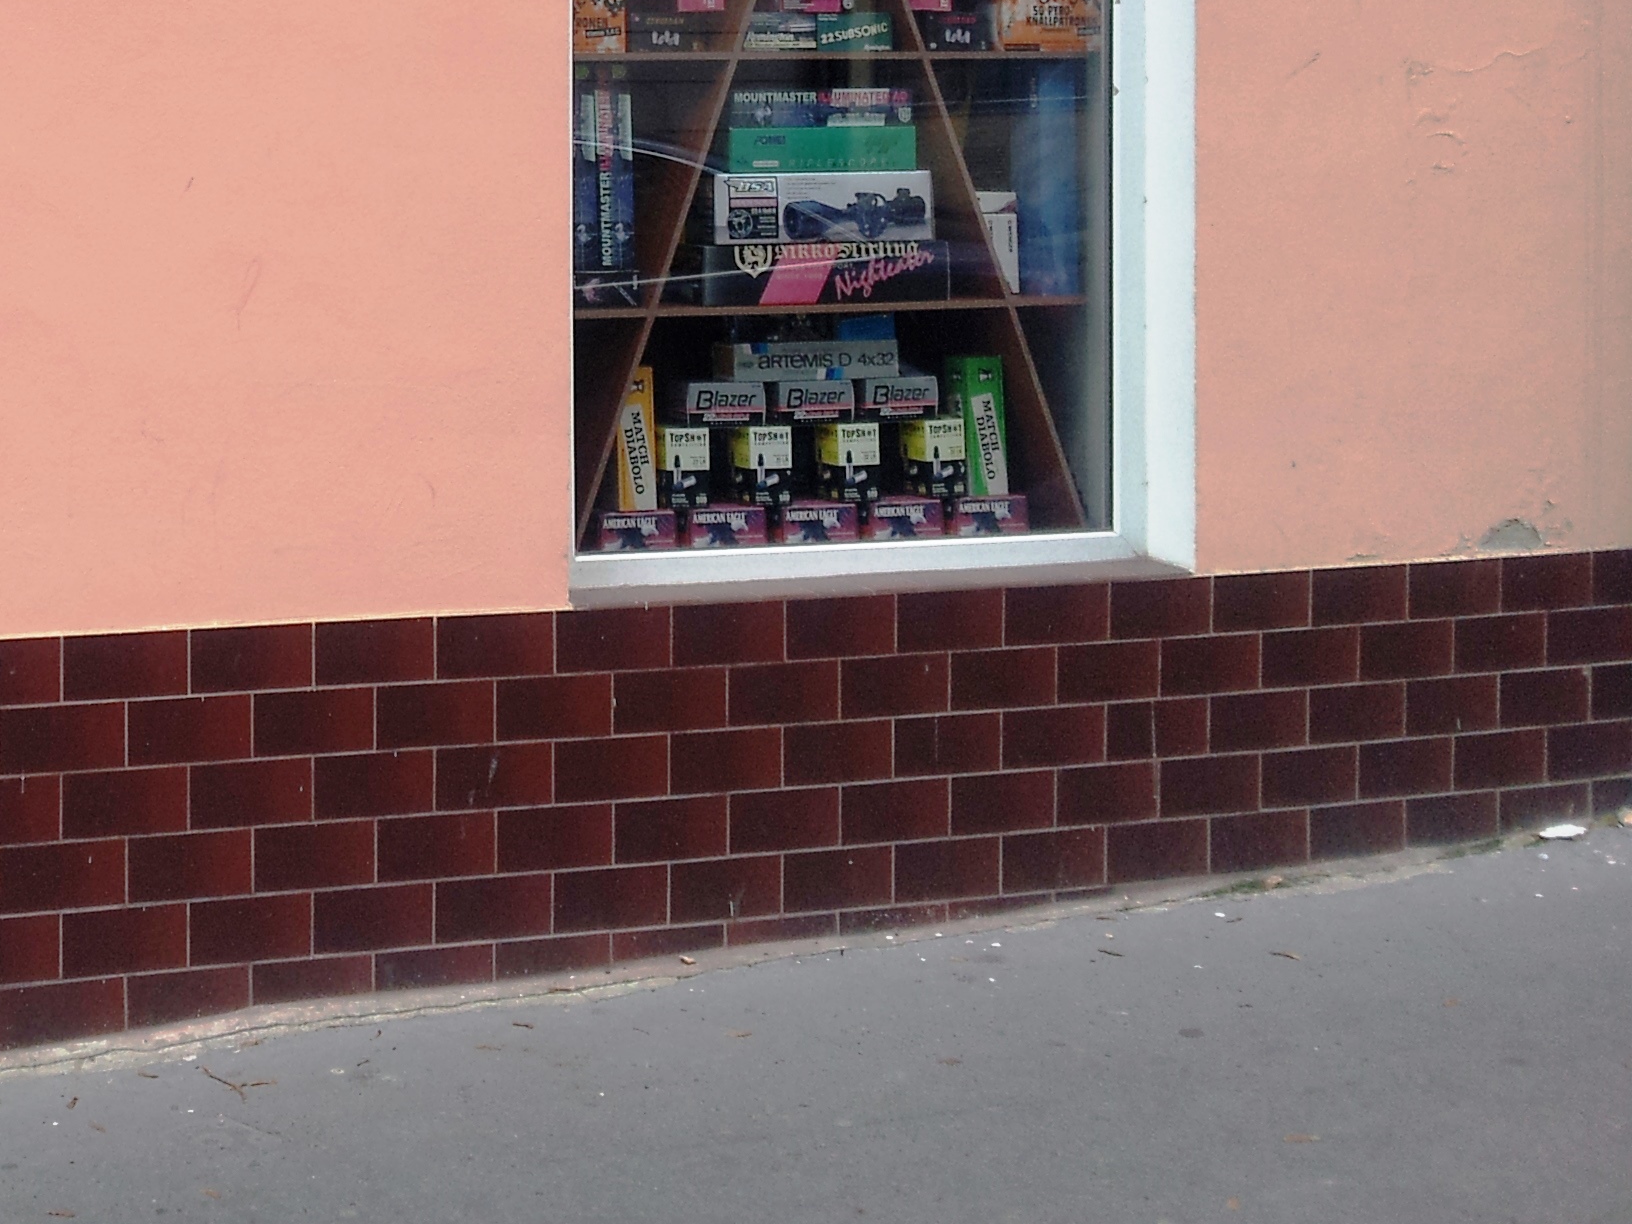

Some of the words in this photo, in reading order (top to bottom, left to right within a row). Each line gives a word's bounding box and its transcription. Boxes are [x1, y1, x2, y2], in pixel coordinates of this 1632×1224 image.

[820, 32, 835, 45] 22
[835, 22, 889, 43] SUBSONIC
[733, 91, 817, 104] MOUNTMASTER
[599, 171, 613, 266] MOUNTMASTER
[838, 352, 852, 367] D
[857, 352, 894, 367] 4x32
[695, 390, 757, 411] Blazer
[787, 388, 845, 409] Blazer
[872, 384, 930, 406] Blazer
[981, 400, 1000, 451] MATCH
[631, 411, 649, 466] MATCH
[976, 417, 996, 480] DIABOLO
[624, 428, 645, 495] DIABOLO
[785, 510, 818, 522] AMERICAN
[819, 509, 838, 521] EAGLE
[874, 506, 905, 518] AMERICAN
[906, 505, 925, 517] EAGLE
[959, 501, 989, 513] AMERICAN
[990, 500, 1011, 512] EAGLE
[603, 517, 636, 529] AMERICAN
[637, 516, 657, 527] EAGLE
[692, 513, 726, 524] AMERICAN
[727, 512, 747, 523] EAGLE
